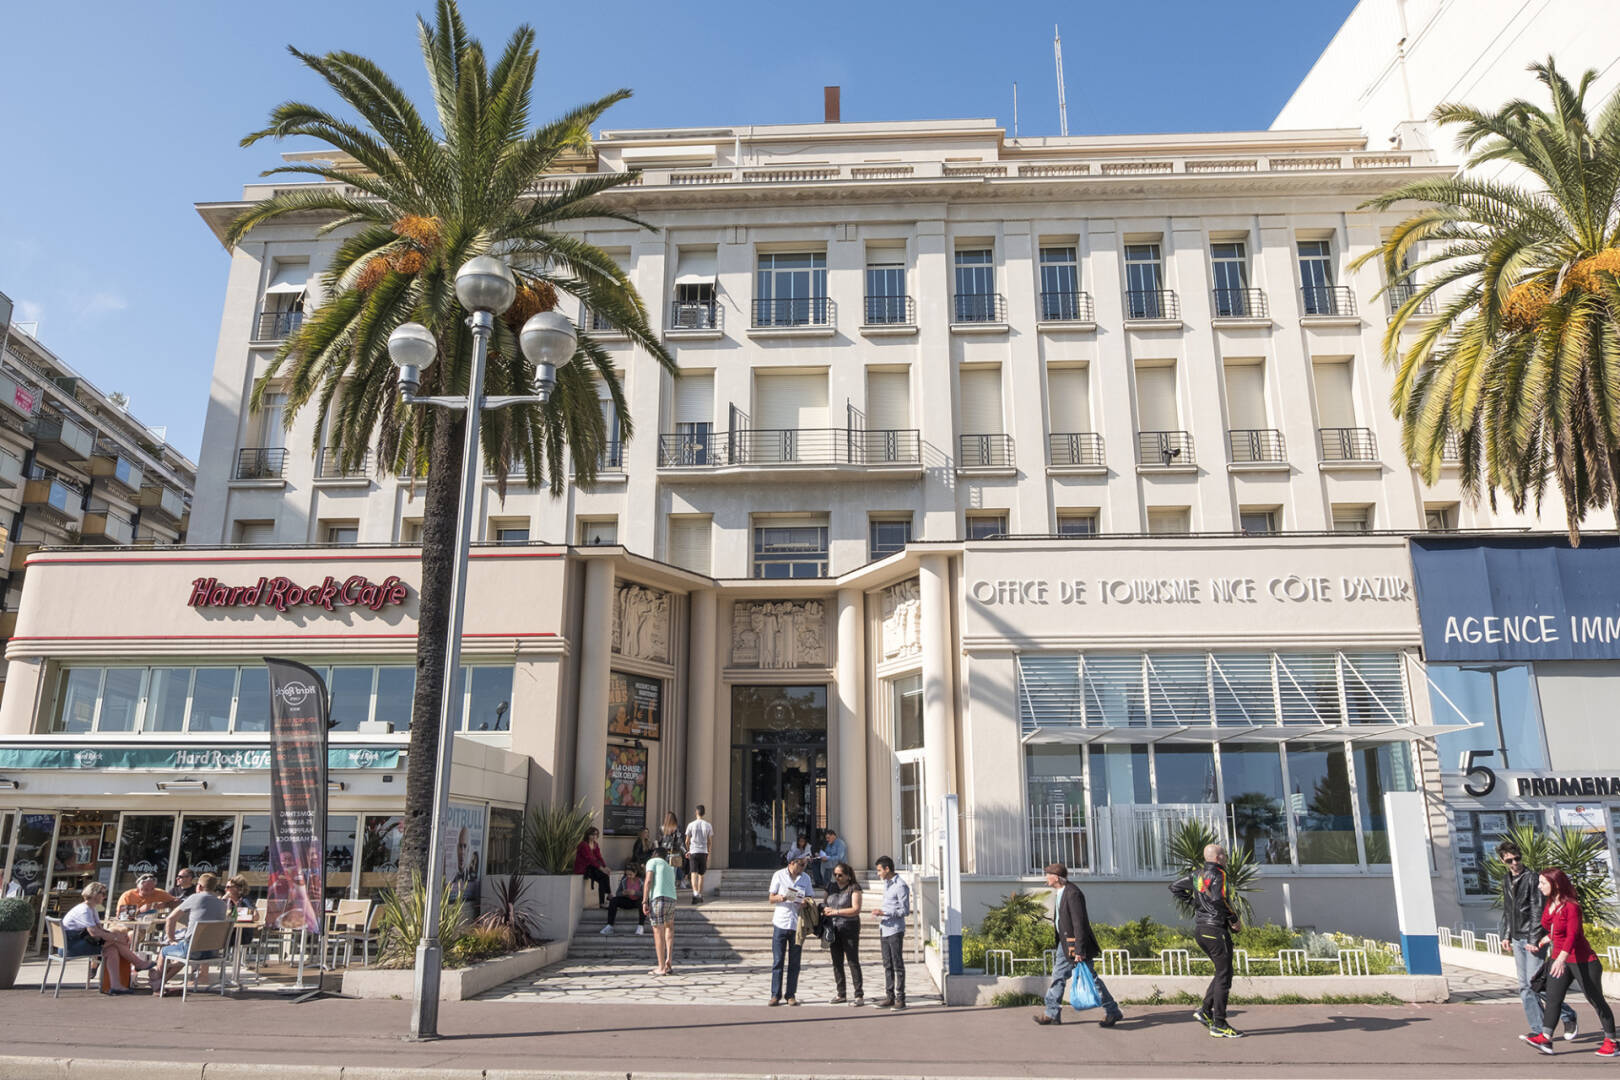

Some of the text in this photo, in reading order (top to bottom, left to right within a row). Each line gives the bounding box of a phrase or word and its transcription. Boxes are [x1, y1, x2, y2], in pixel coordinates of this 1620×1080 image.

[187, 575, 409, 612] Hard Rock Cafe
[972, 574, 1412, 604] OFFICE DE TOURISME NICE CÔTE D'AZUR
[1445, 615, 1620, 644] AGENCE IMM
[176, 750, 271, 768] Hard Rock Cafe
[1459, 750, 1496, 797] 5
